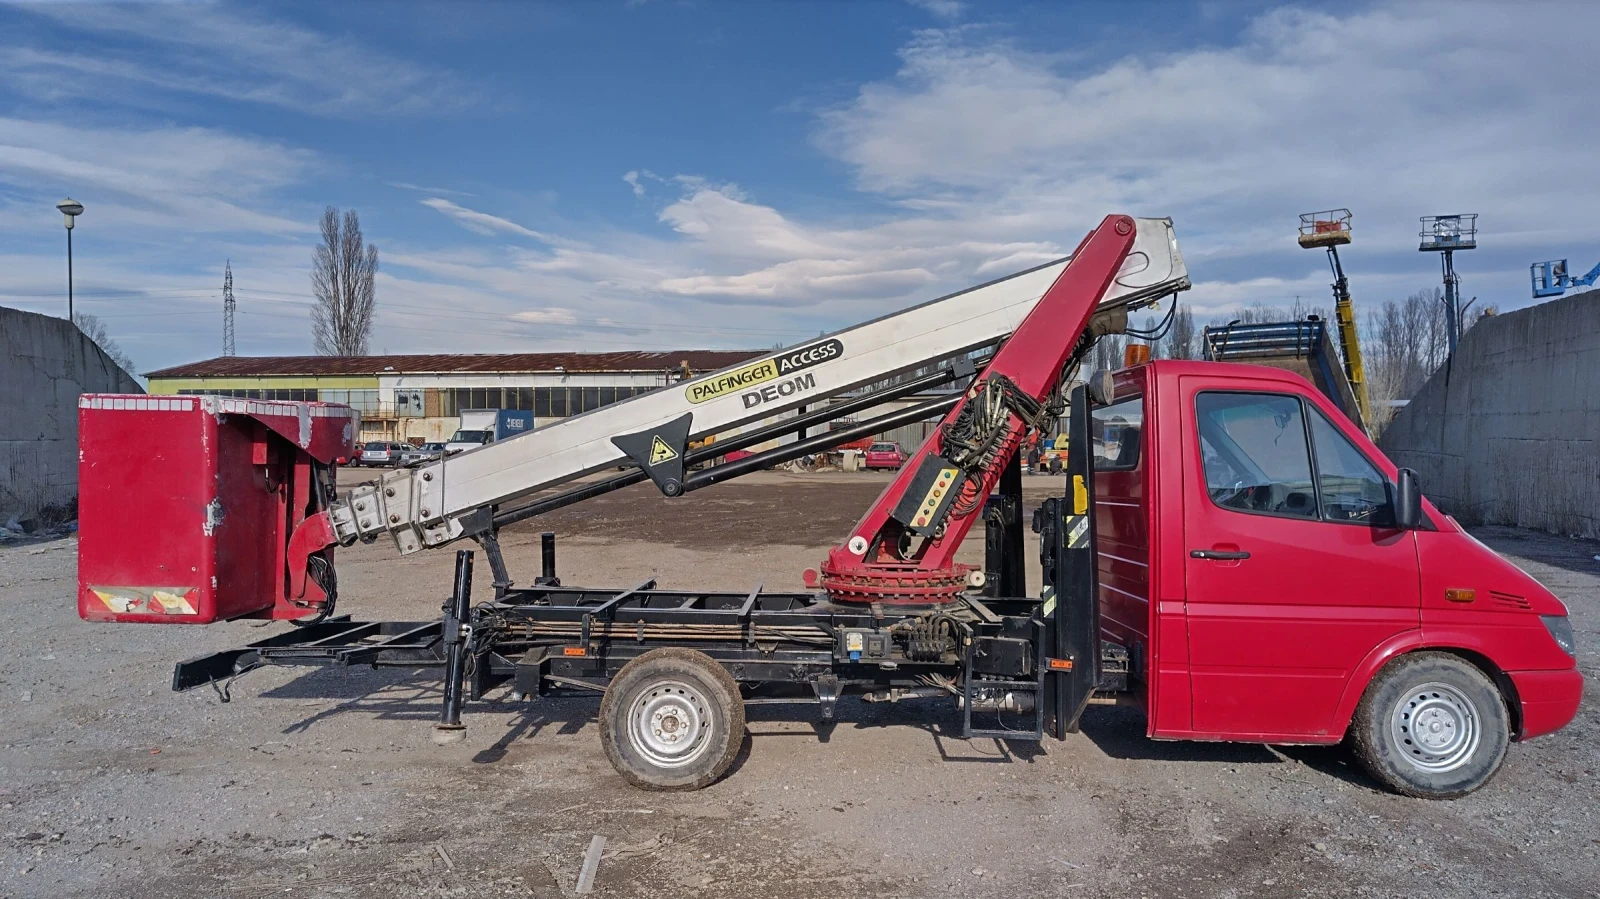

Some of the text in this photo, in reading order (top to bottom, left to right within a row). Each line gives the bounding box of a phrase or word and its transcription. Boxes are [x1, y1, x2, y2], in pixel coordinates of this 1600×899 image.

[693, 342, 837, 399] PALFINGER ACCESS
[741, 372, 816, 409] DEOM
